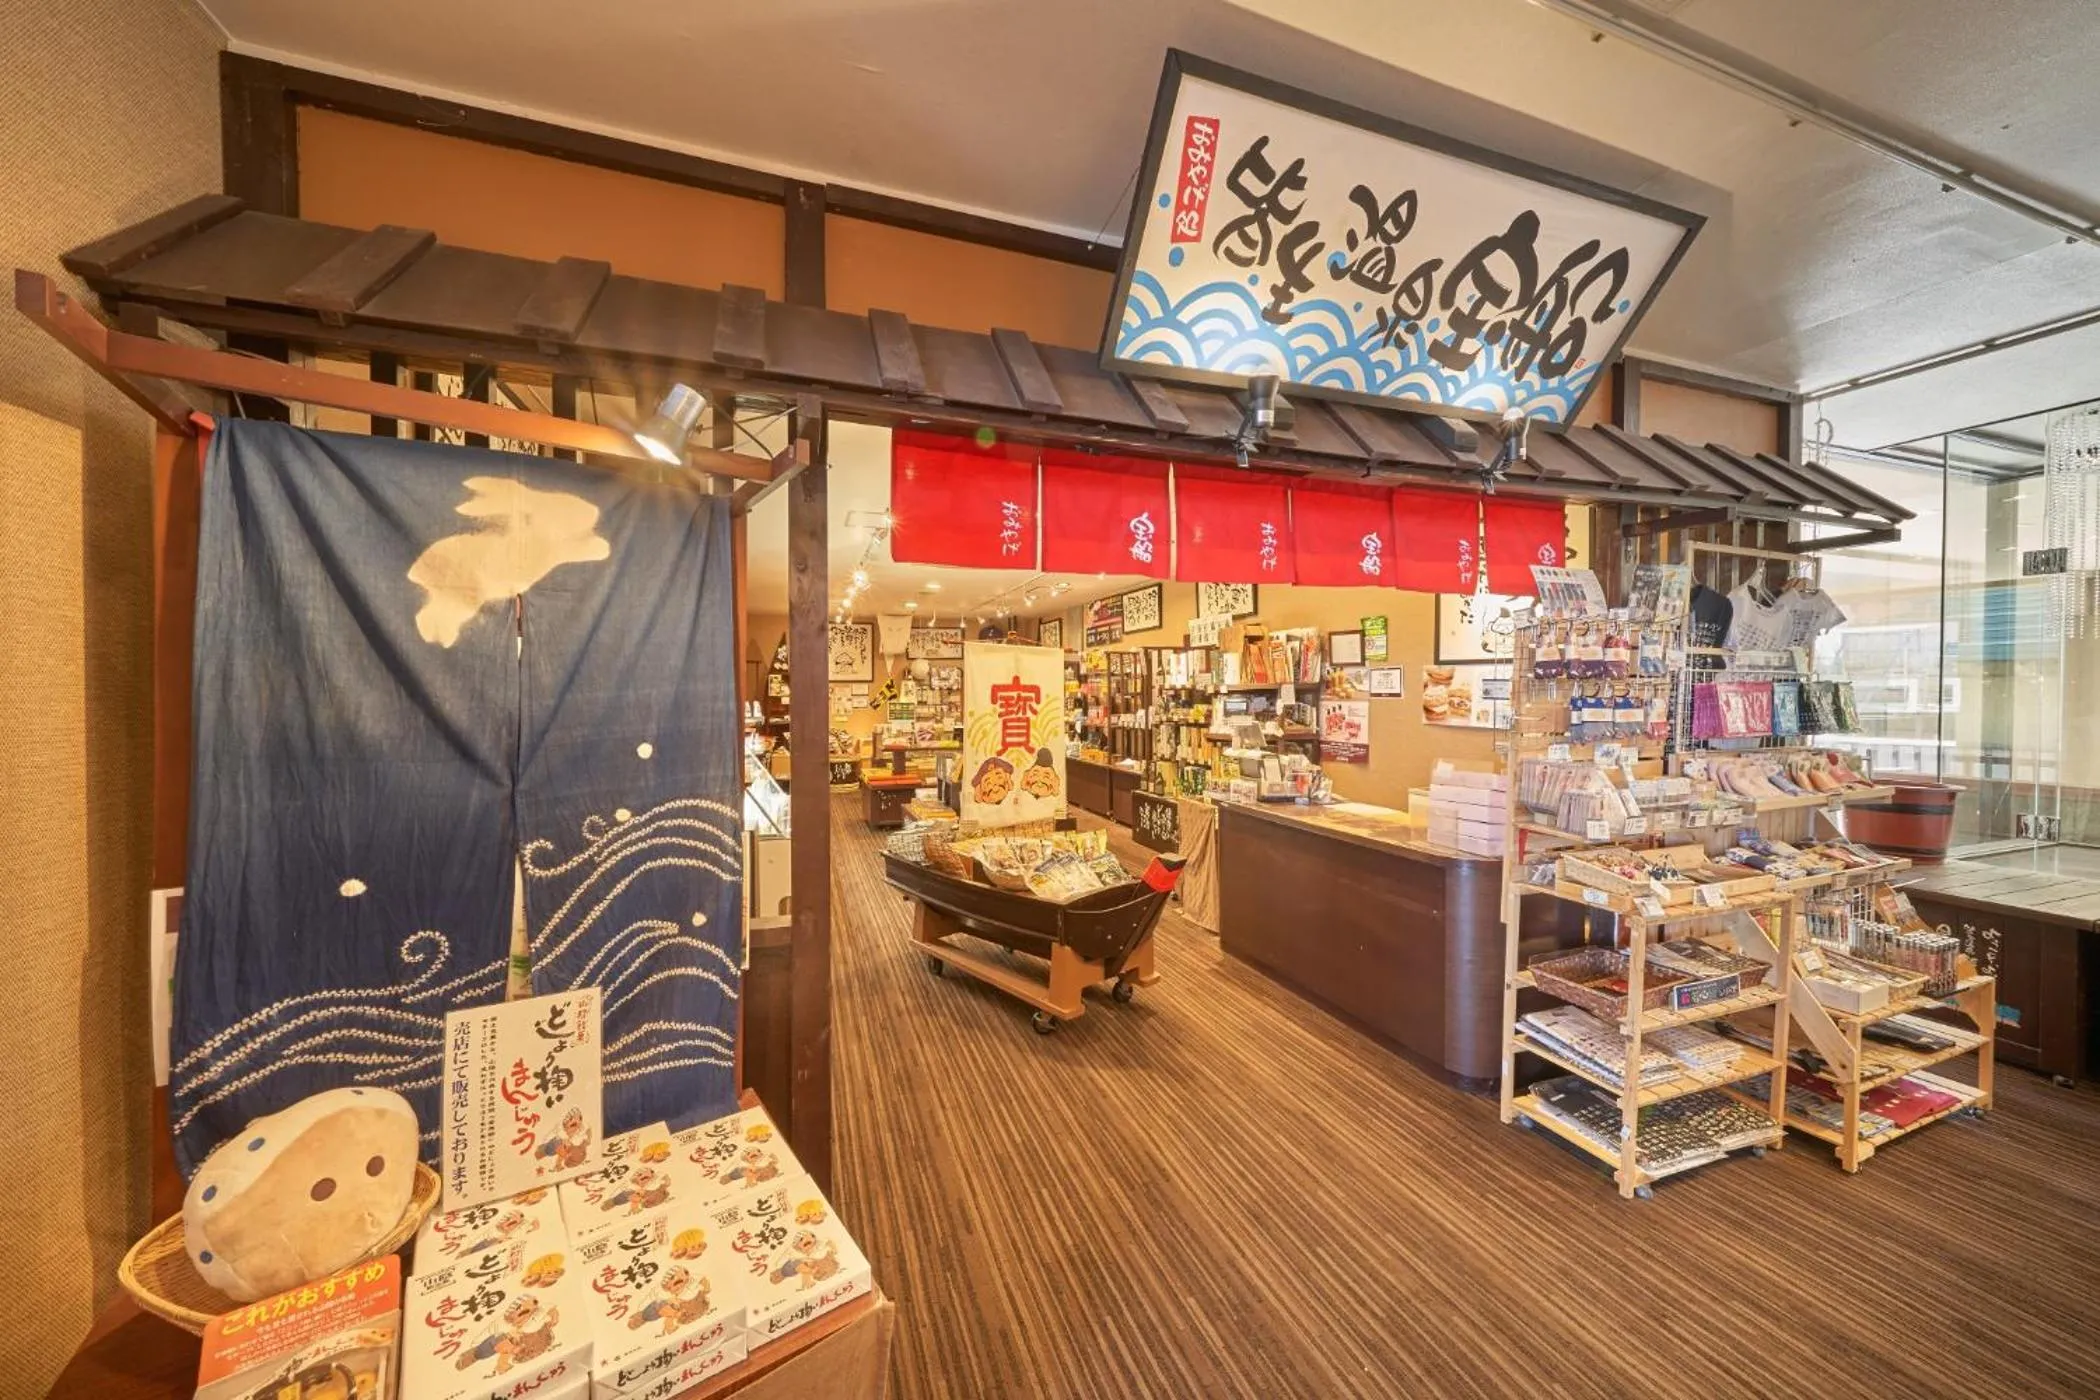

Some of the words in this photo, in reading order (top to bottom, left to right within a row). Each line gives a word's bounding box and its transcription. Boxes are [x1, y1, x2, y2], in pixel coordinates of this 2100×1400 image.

[501, 1056, 542, 1157] まんじゅう
[220, 1261, 386, 1337] これがおすすめ
